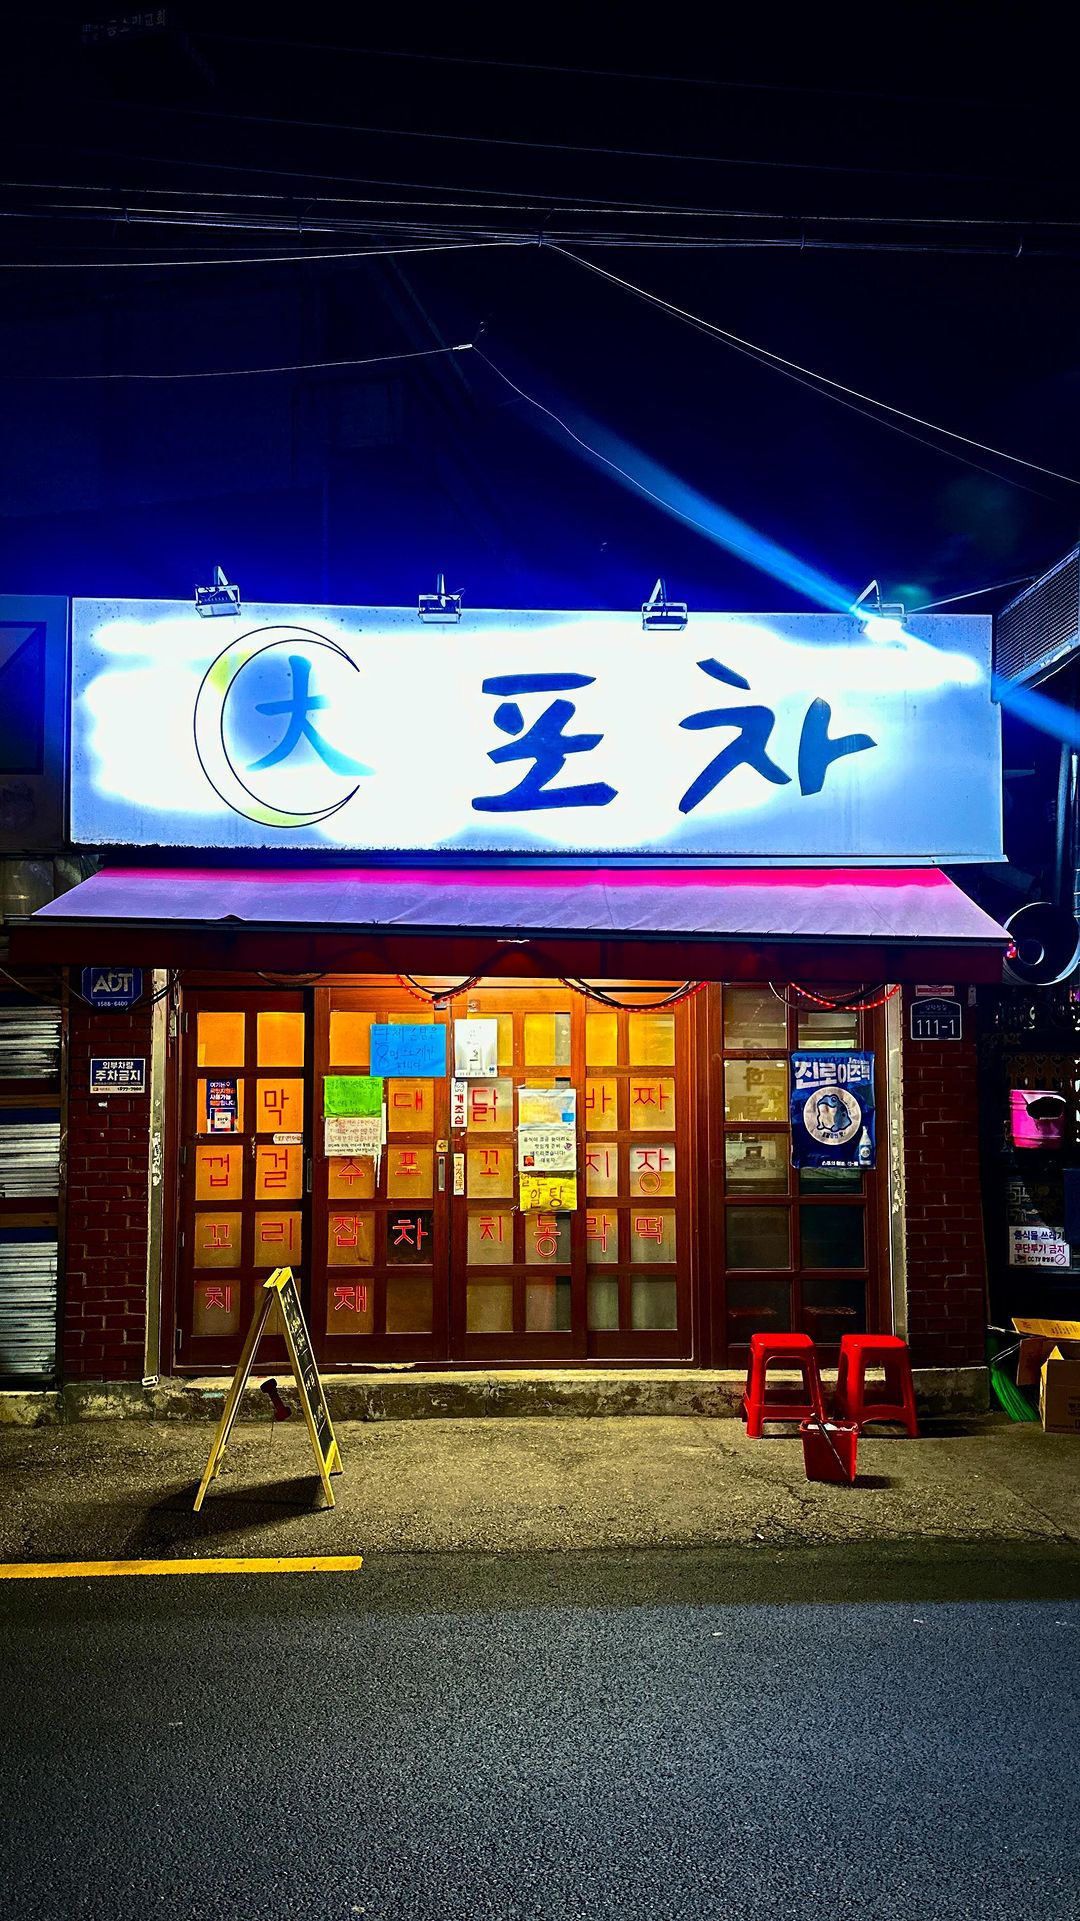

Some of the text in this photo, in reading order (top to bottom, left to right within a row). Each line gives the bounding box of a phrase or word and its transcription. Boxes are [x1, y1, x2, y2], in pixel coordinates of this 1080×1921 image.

[245, 654, 878, 814] 大 포차
[92, 970, 133, 993] ADT
[916, 1019, 955, 1036] 111-1
[102, 1061, 134, 1070] 외부차량
[95, 1069, 141, 1082] 주차금지
[454, 1093, 465, 1125] 개조심
[530, 1185, 564, 1209] 알탕
[1014, 1230, 1038, 1240] 음식물
[1014, 1243, 1065, 1254] 무단투기 금지
